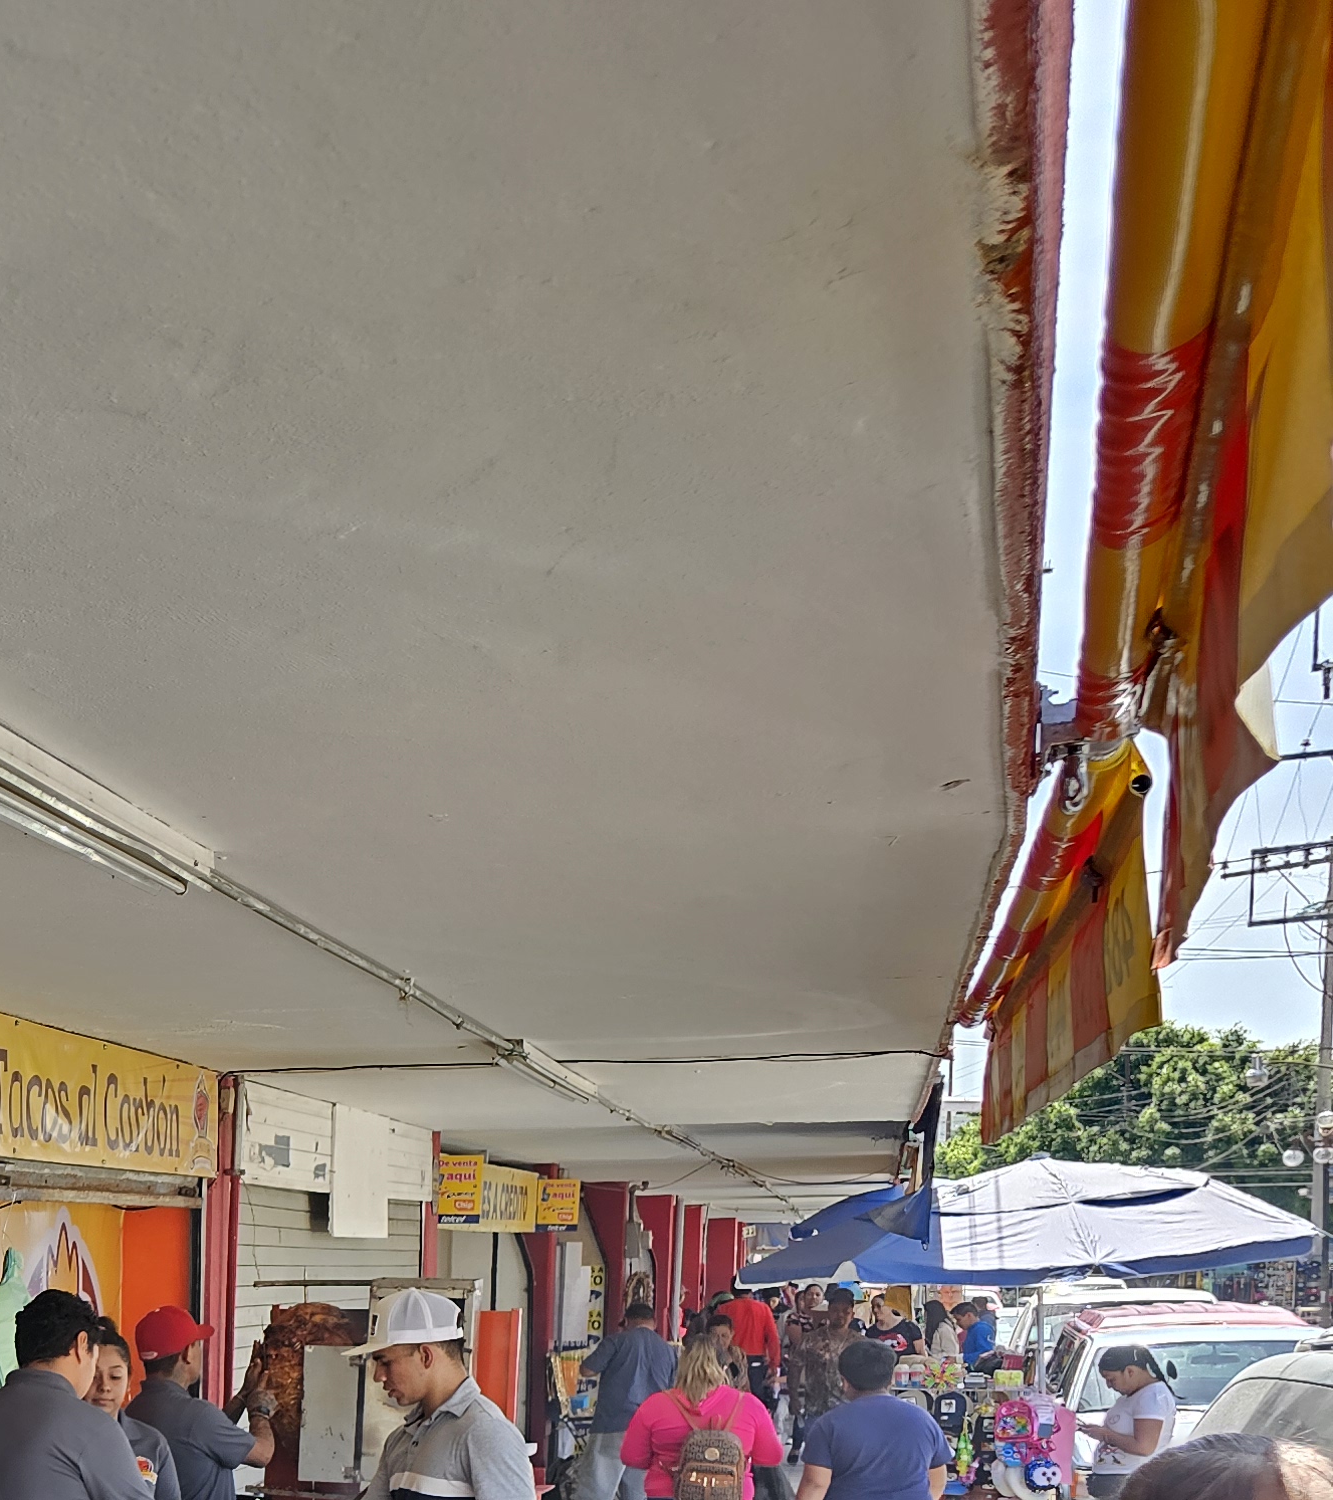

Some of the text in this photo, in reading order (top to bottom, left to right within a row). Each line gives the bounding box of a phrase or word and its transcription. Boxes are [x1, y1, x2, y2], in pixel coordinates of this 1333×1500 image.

[77, 1063, 98, 1147] al
[446, 1170, 477, 1183] aquí
[455, 1201, 475, 1211] Chip
